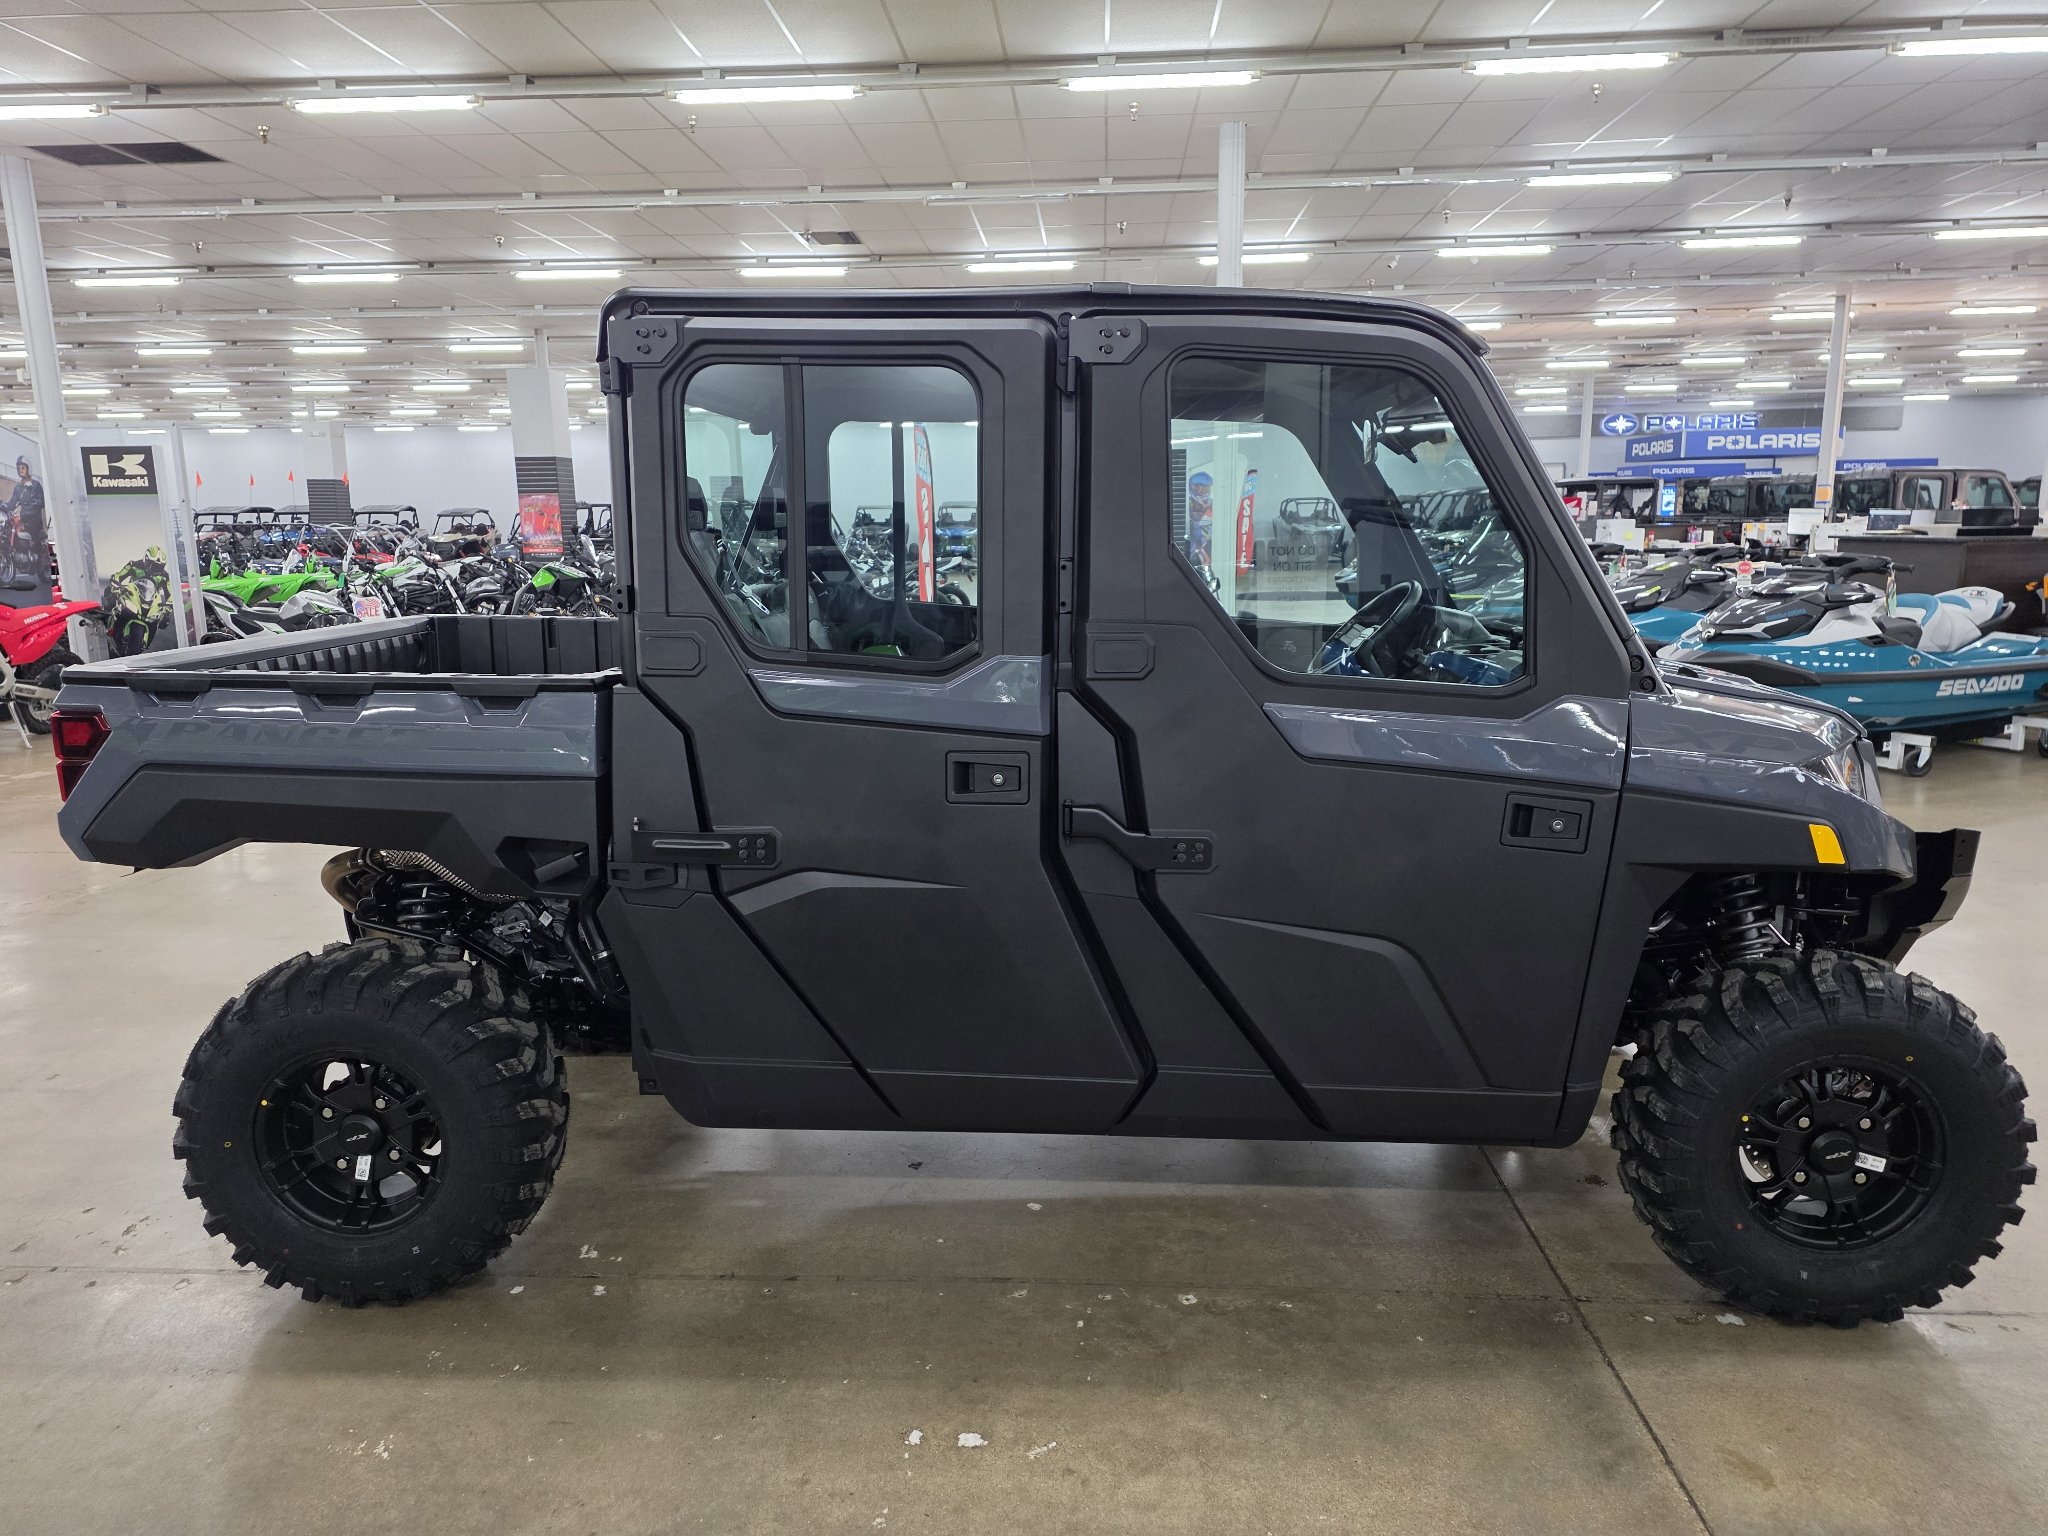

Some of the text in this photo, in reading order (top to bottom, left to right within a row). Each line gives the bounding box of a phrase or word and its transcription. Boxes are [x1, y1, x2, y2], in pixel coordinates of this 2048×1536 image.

[1644, 412, 1760, 432] POLARIS
[1631, 439, 1674, 457] POLARIS
[1708, 433, 1821, 450] POLARIS
[1652, 467, 1695, 475] POLARIS
[92, 476, 149, 488] Kawasaki
[23, 612, 49, 625] HONDA
[357, 606, 380, 618] SALE
